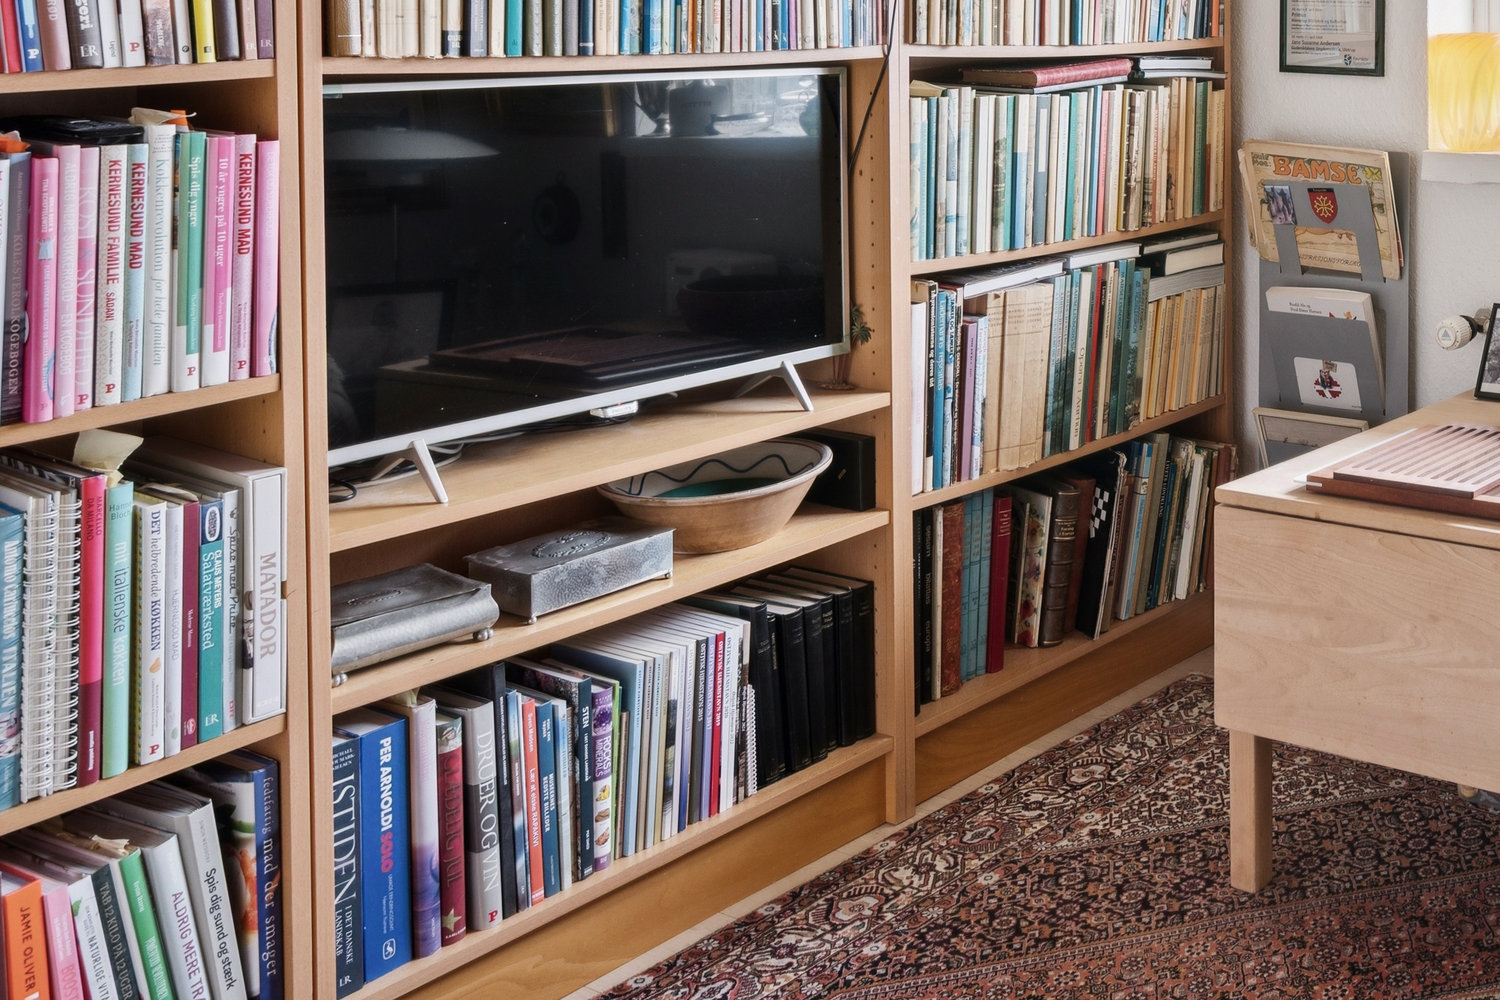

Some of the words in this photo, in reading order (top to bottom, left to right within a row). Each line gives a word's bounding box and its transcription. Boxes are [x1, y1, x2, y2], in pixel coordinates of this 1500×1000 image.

[188, 157, 200, 179] Spis
[218, 157, 228, 170] 10
[218, 171, 228, 183] år
[1273, 155, 1362, 184] BAMSE
[107, 160, 122, 233] KERNESUND
[129, 162, 145, 238] KERNESUND
[189, 181, 200, 198] dig
[215, 185, 227, 213] yngre
[238, 153, 252, 225] KERNESUND
[153, 158, 170, 272] Køkkenrevolution
[188, 200, 200, 227] yngre
[215, 215, 226, 229] på
[217, 230, 226, 243] 10
[237, 228, 251, 255] MAD
[106, 236, 120, 286] FAMILIE
[129, 242, 142, 270] MAD
[215, 244, 226, 266] uger
[152, 276, 166, 295] for
[105, 292, 116, 322] SÅDAN!
[153, 296, 166, 318] hele
[151, 320, 166, 366] familien
[929, 349, 934, 357] og
[1074, 394, 1083, 437] Aarhus
[151, 511, 161, 536] DET
[114, 541, 128, 565] mit
[150, 537, 162, 598] helbredende
[214, 550, 222, 575] CLAUS
[113, 568, 129, 633] italienske
[201, 552, 215, 650] Salatværksted
[214, 576, 222, 609] MEYERS
[260, 552, 277, 659] MATADOR
[150, 599, 161, 651] KØKKEN
[112, 636, 126, 686] køkken
[379, 736, 392, 765] PER
[595, 738, 604, 777] MINERALS
[603, 735, 612, 769] ROCKS
[477, 731, 496, 813] DRUER
[530, 782, 537, 791] at
[262, 777, 274, 835] fedtfattig
[379, 767, 393, 832] ARNOLDI
[530, 792, 538, 811] elske
[480, 814, 498, 849] OG
[531, 812, 539, 847] RAPAKIVI
[543, 802, 551, 832] BILLEDER
[333, 773, 357, 905] ISTIDEN
[381, 833, 394, 873] SOLO
[263, 838, 278, 874] mad
[483, 850, 499, 892] VIN
[204, 868, 218, 893] Spis
[264, 881, 278, 909] der
[209, 895, 223, 914] dig
[20, 907, 33, 943] JAMIE
[214, 914, 228, 940] sund
[217, 942, 229, 956] og
[262, 914, 279, 976] smager
[23, 947, 37, 992] OLIVER
[221, 957, 237, 991] stærk
